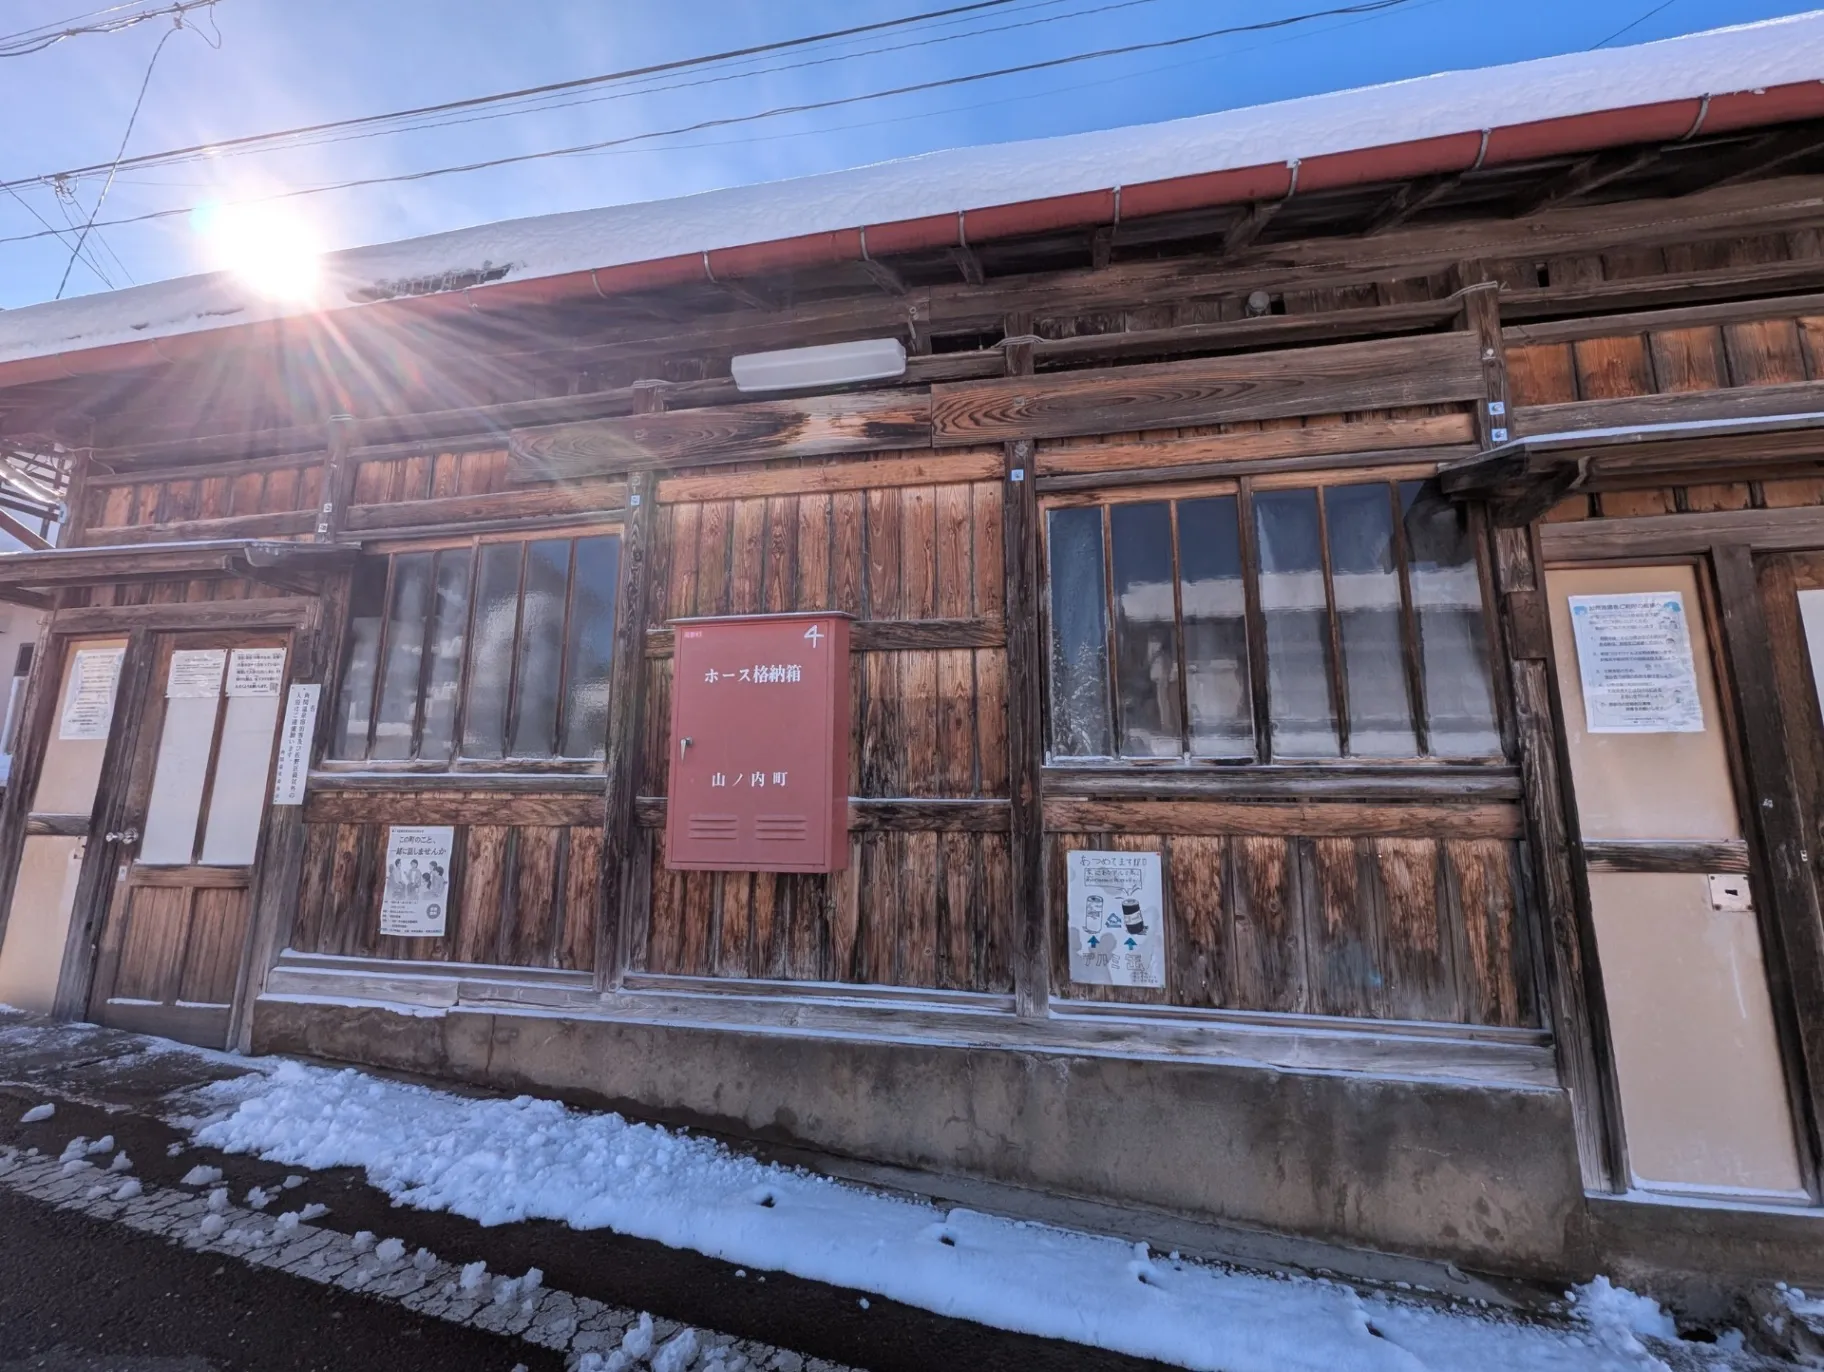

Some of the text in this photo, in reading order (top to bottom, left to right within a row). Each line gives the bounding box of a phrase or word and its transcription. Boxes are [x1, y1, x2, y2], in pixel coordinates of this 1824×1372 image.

[804, 624, 825, 649] 4
[704, 664, 802, 684] ホース格納箱
[711, 771, 788, 787] 山ノ内町
